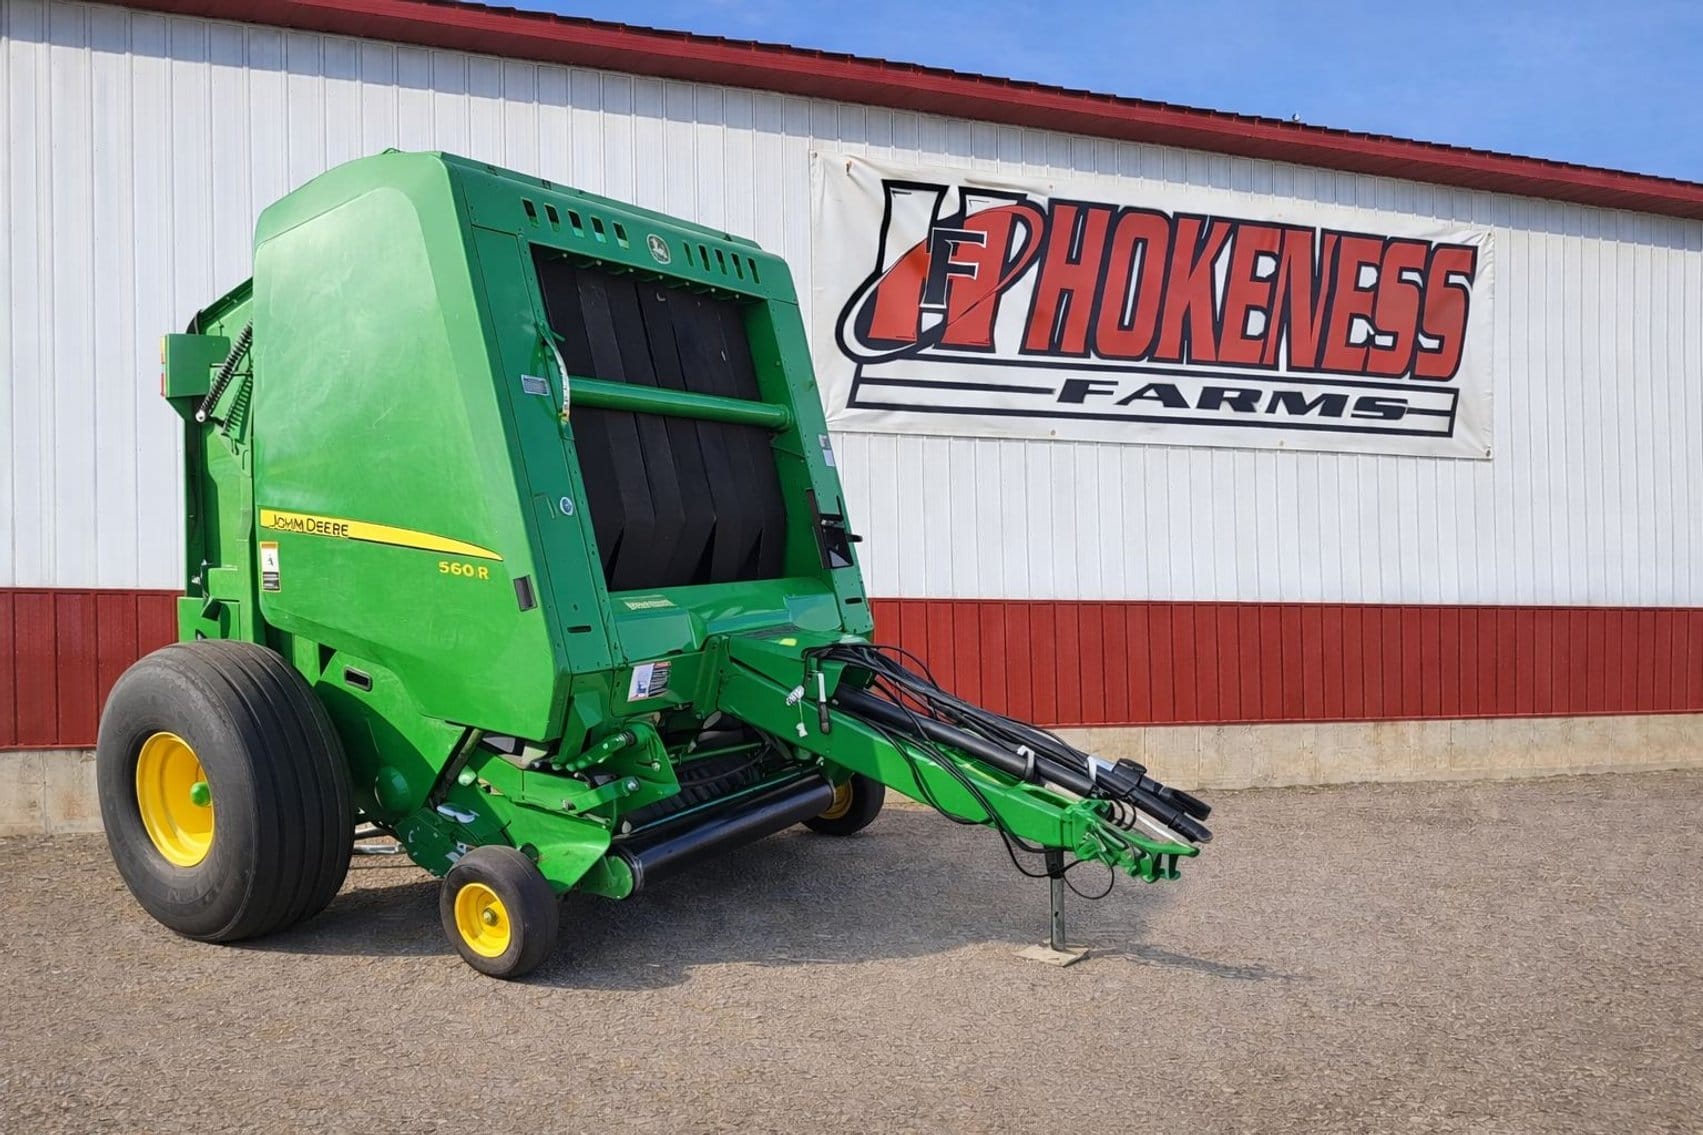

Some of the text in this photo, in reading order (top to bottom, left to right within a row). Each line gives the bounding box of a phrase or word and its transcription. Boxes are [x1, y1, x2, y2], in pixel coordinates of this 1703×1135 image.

[1018, 197, 1478, 381] HOKENESS
[1056, 378, 1408, 421] FARMS
[306, 518, 349, 537] DEERE
